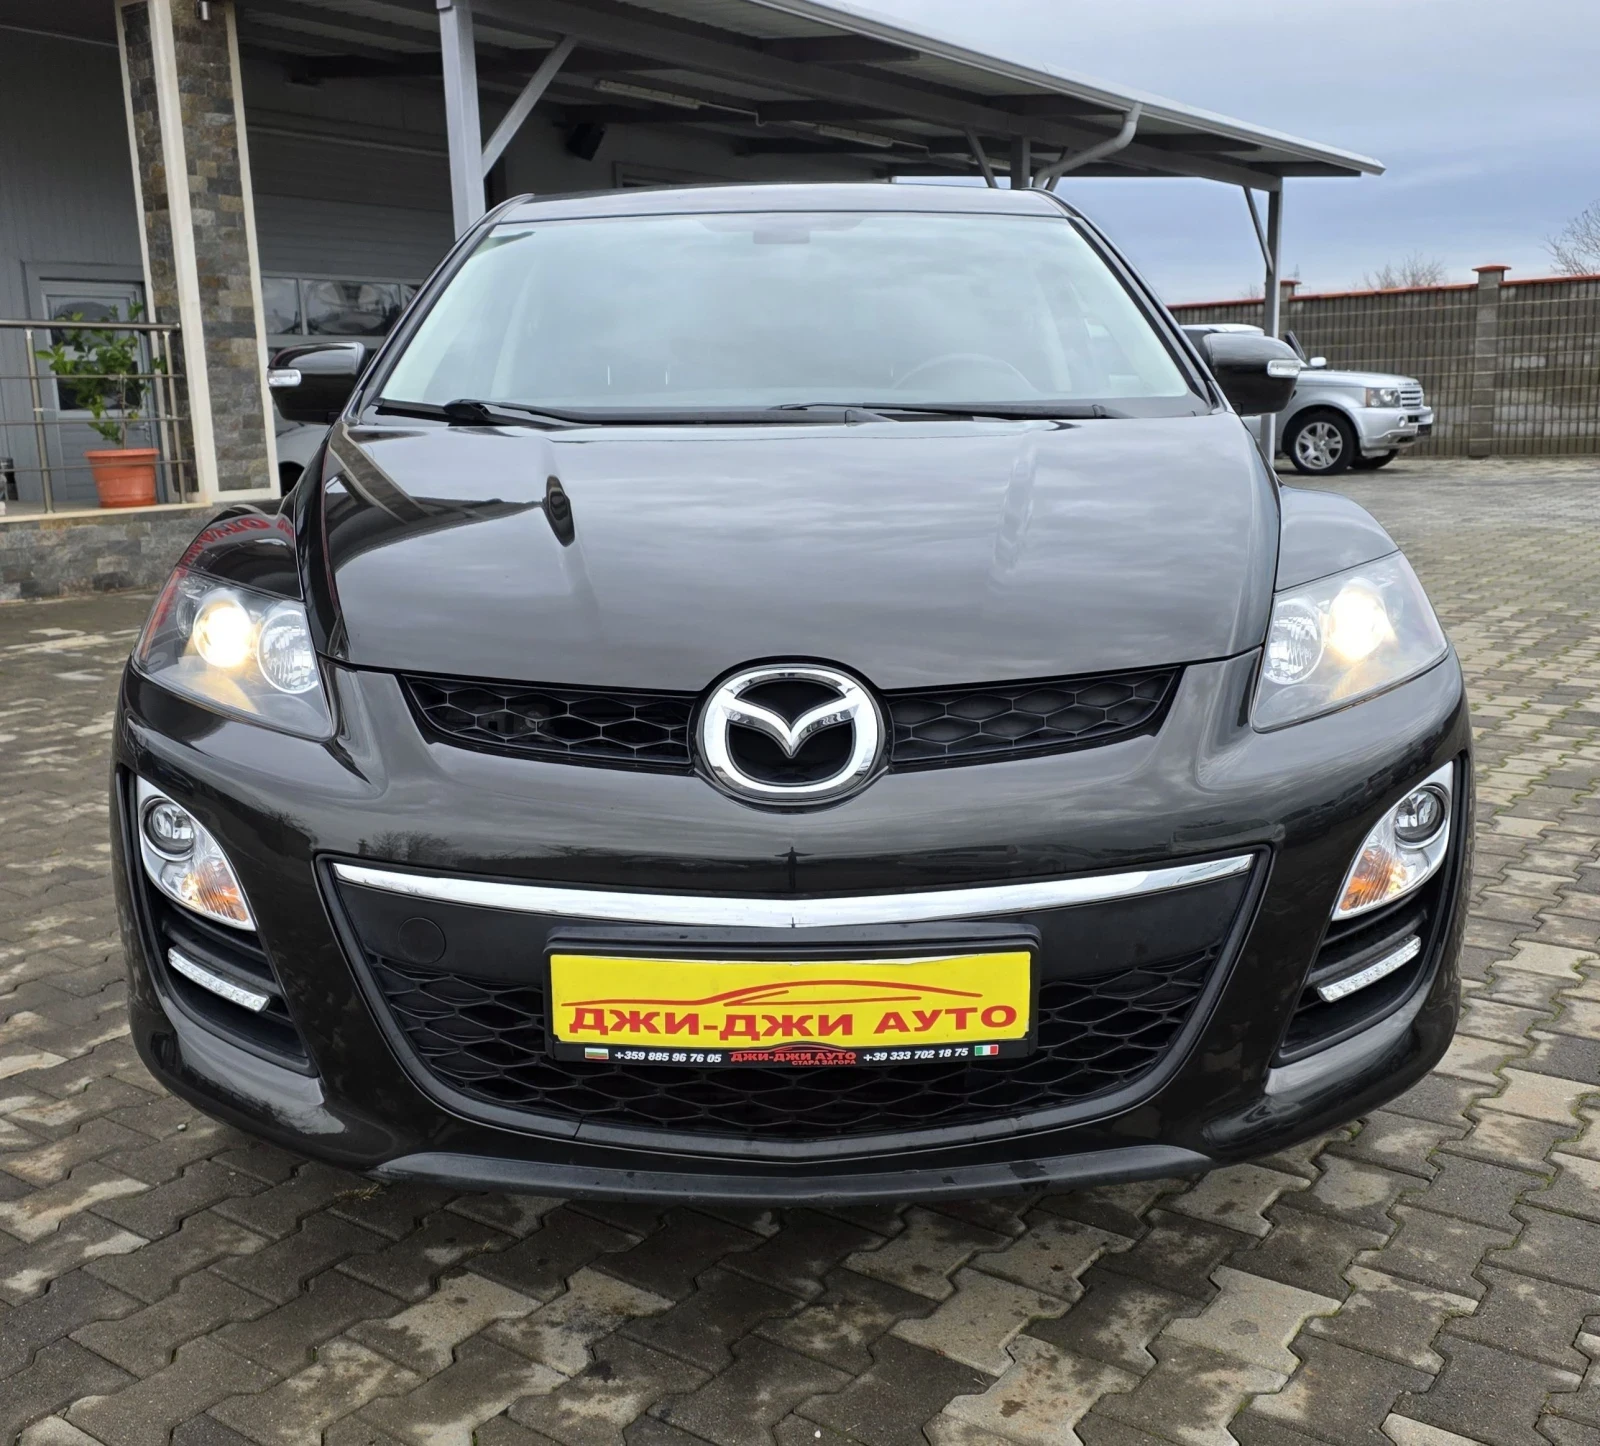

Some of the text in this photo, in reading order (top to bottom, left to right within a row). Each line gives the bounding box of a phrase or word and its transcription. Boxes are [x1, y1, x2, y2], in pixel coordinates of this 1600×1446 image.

[568, 1004, 1018, 1041] ДЖИ-ДЖИ АУТО
[614, 1050, 722, 1063] +359 885 96 76 05
[730, 1051, 857, 1062] ДЖИ-ДЖИ АУТО
[863, 1047, 969, 1062] +39 333 702 18 75
